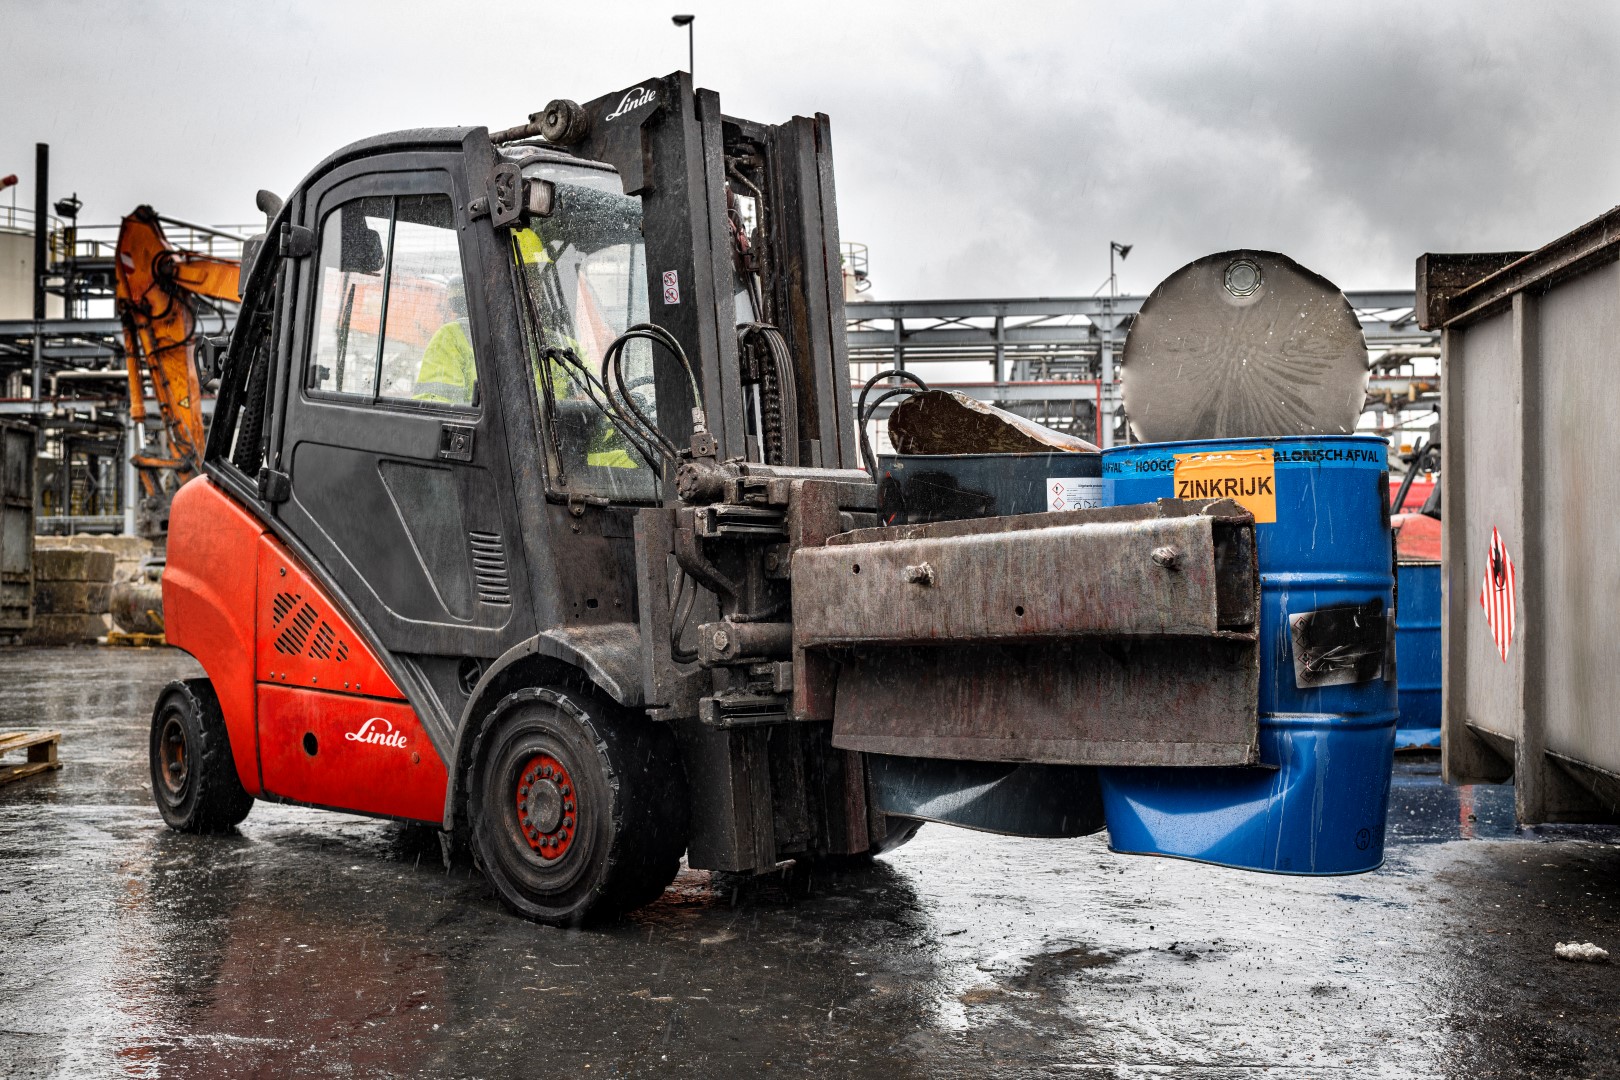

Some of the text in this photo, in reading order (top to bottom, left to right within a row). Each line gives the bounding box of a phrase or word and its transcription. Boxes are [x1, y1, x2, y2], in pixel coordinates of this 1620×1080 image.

[605, 87, 656, 121] Linde
[1346, 449, 1379, 463] AFVAL
[1178, 476, 1273, 499] ZINKRIJK
[344, 717, 408, 748] Linde
